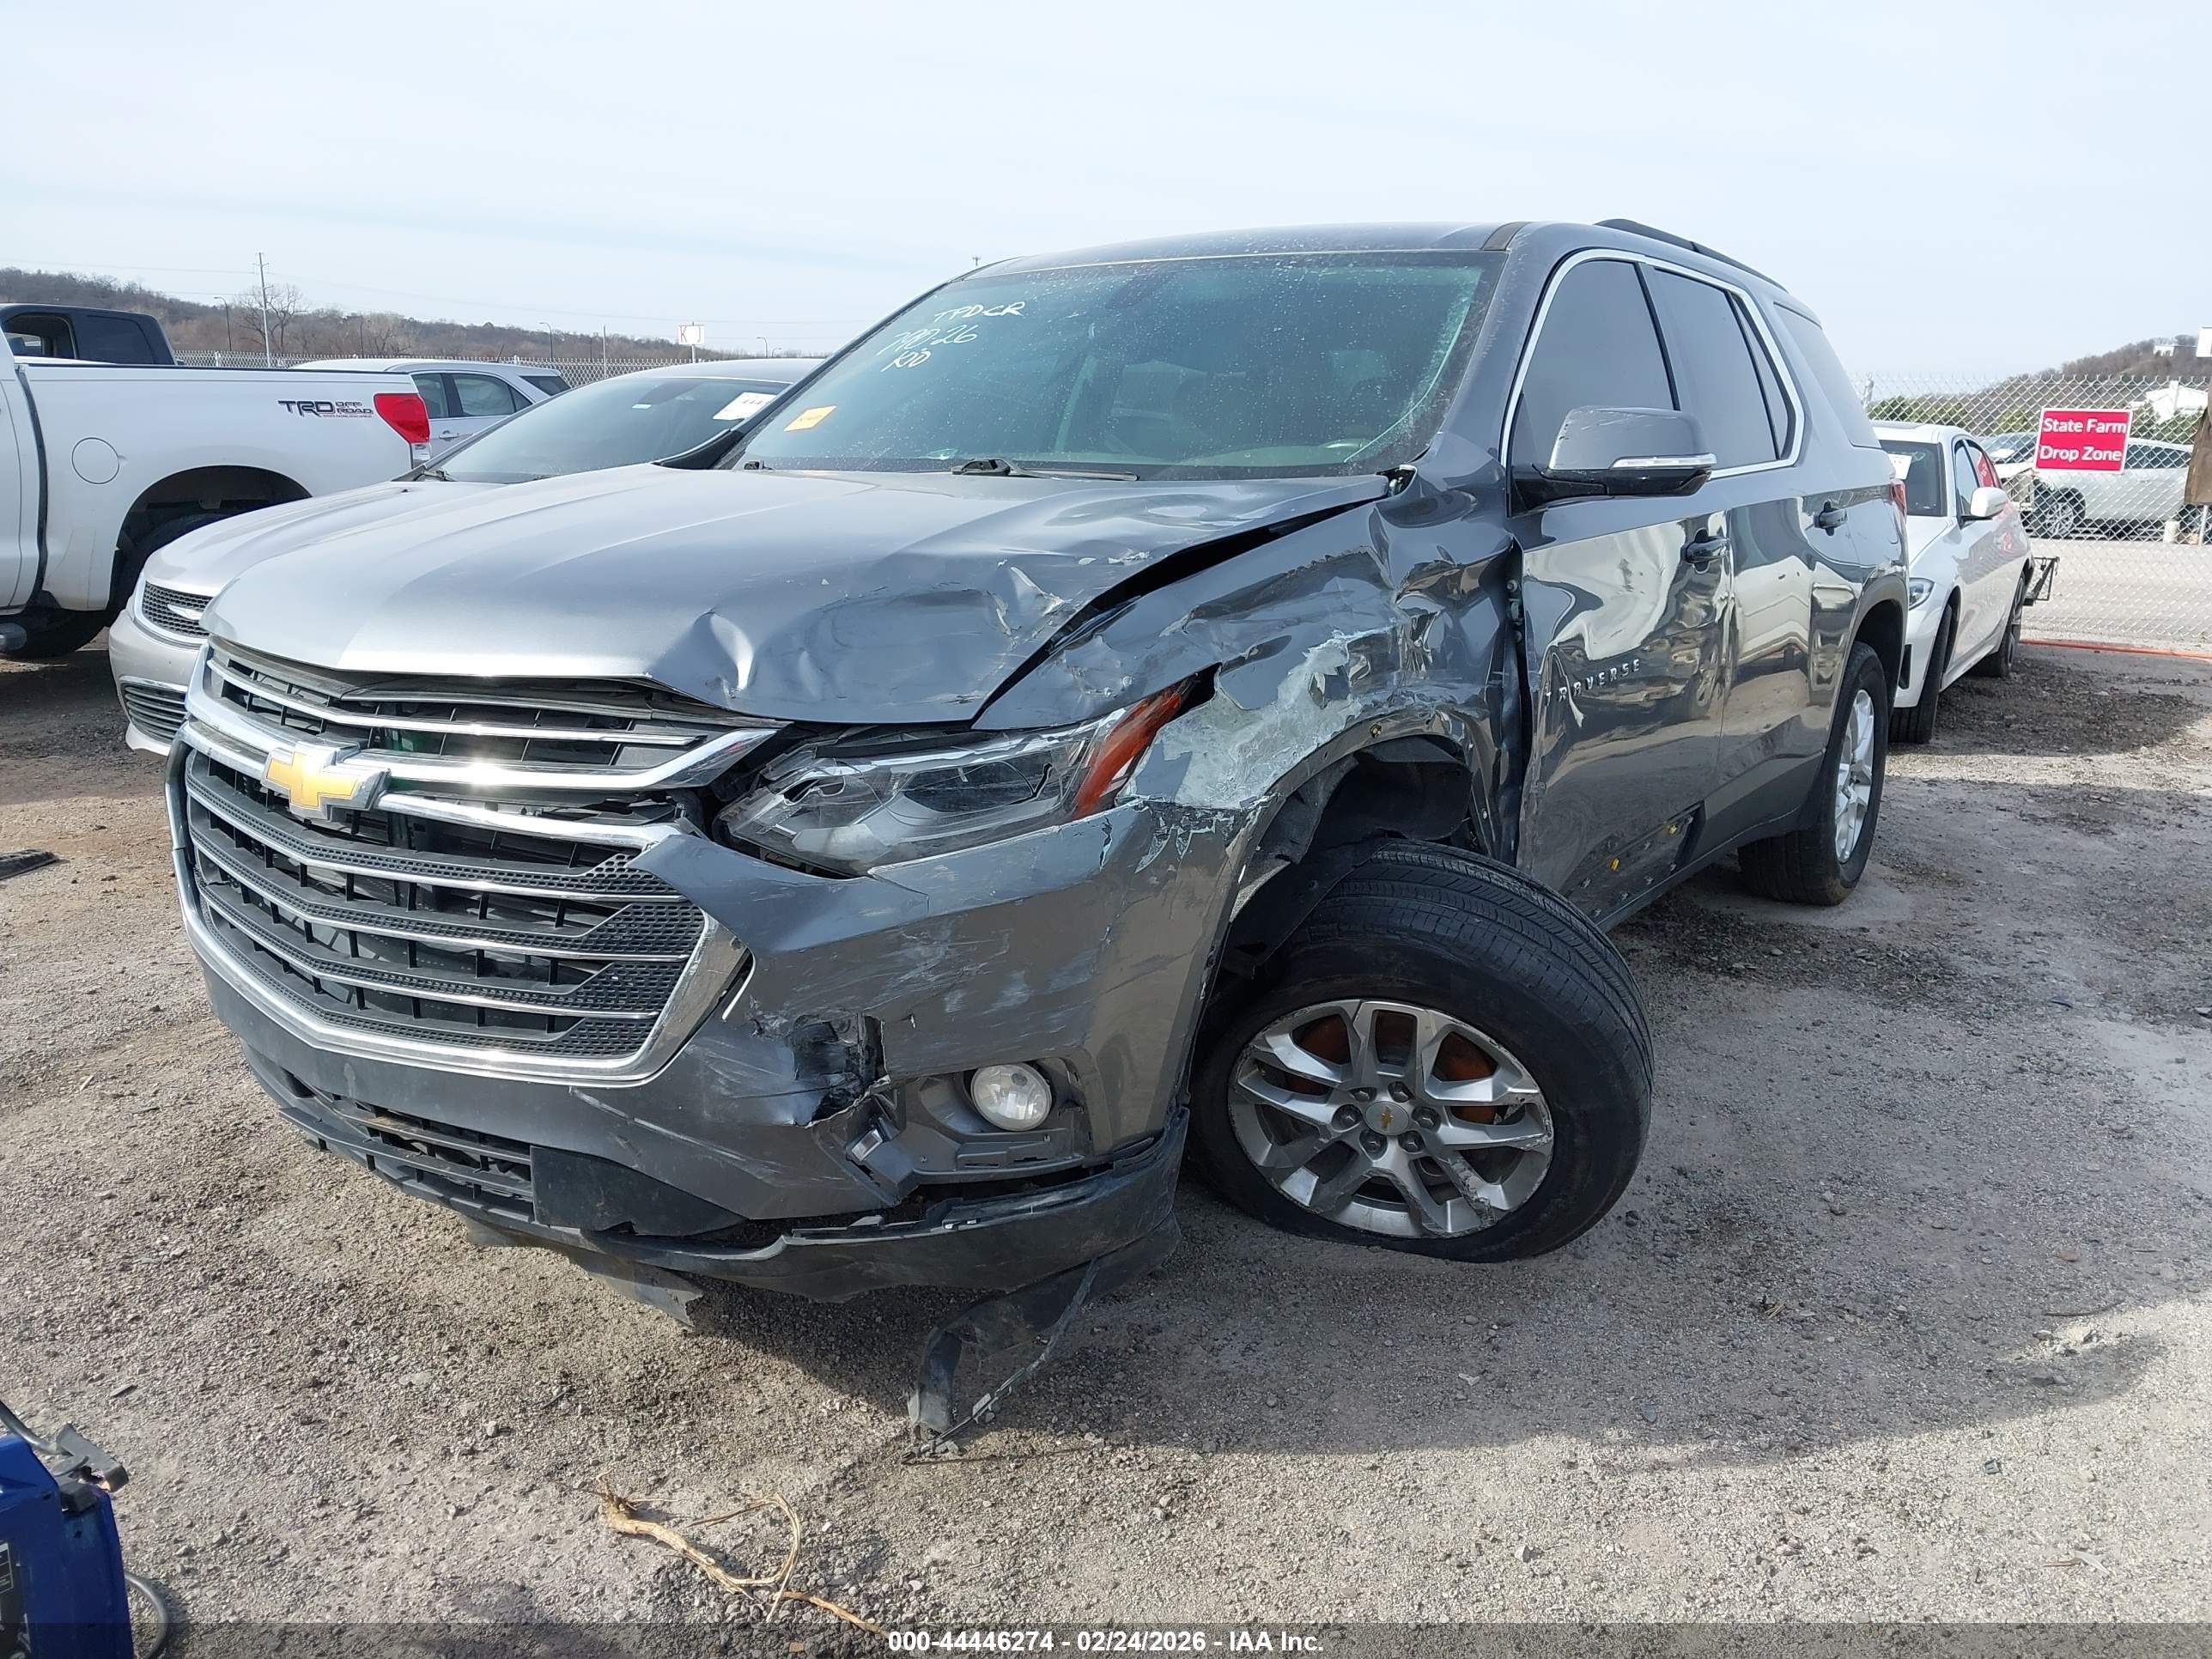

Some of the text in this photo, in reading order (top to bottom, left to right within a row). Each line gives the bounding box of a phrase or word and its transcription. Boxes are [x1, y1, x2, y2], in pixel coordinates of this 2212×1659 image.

[277, 400, 336, 417] TRD
[2043, 417, 2127, 434] State Farm
[2039, 445, 2123, 463] Drop Zone
